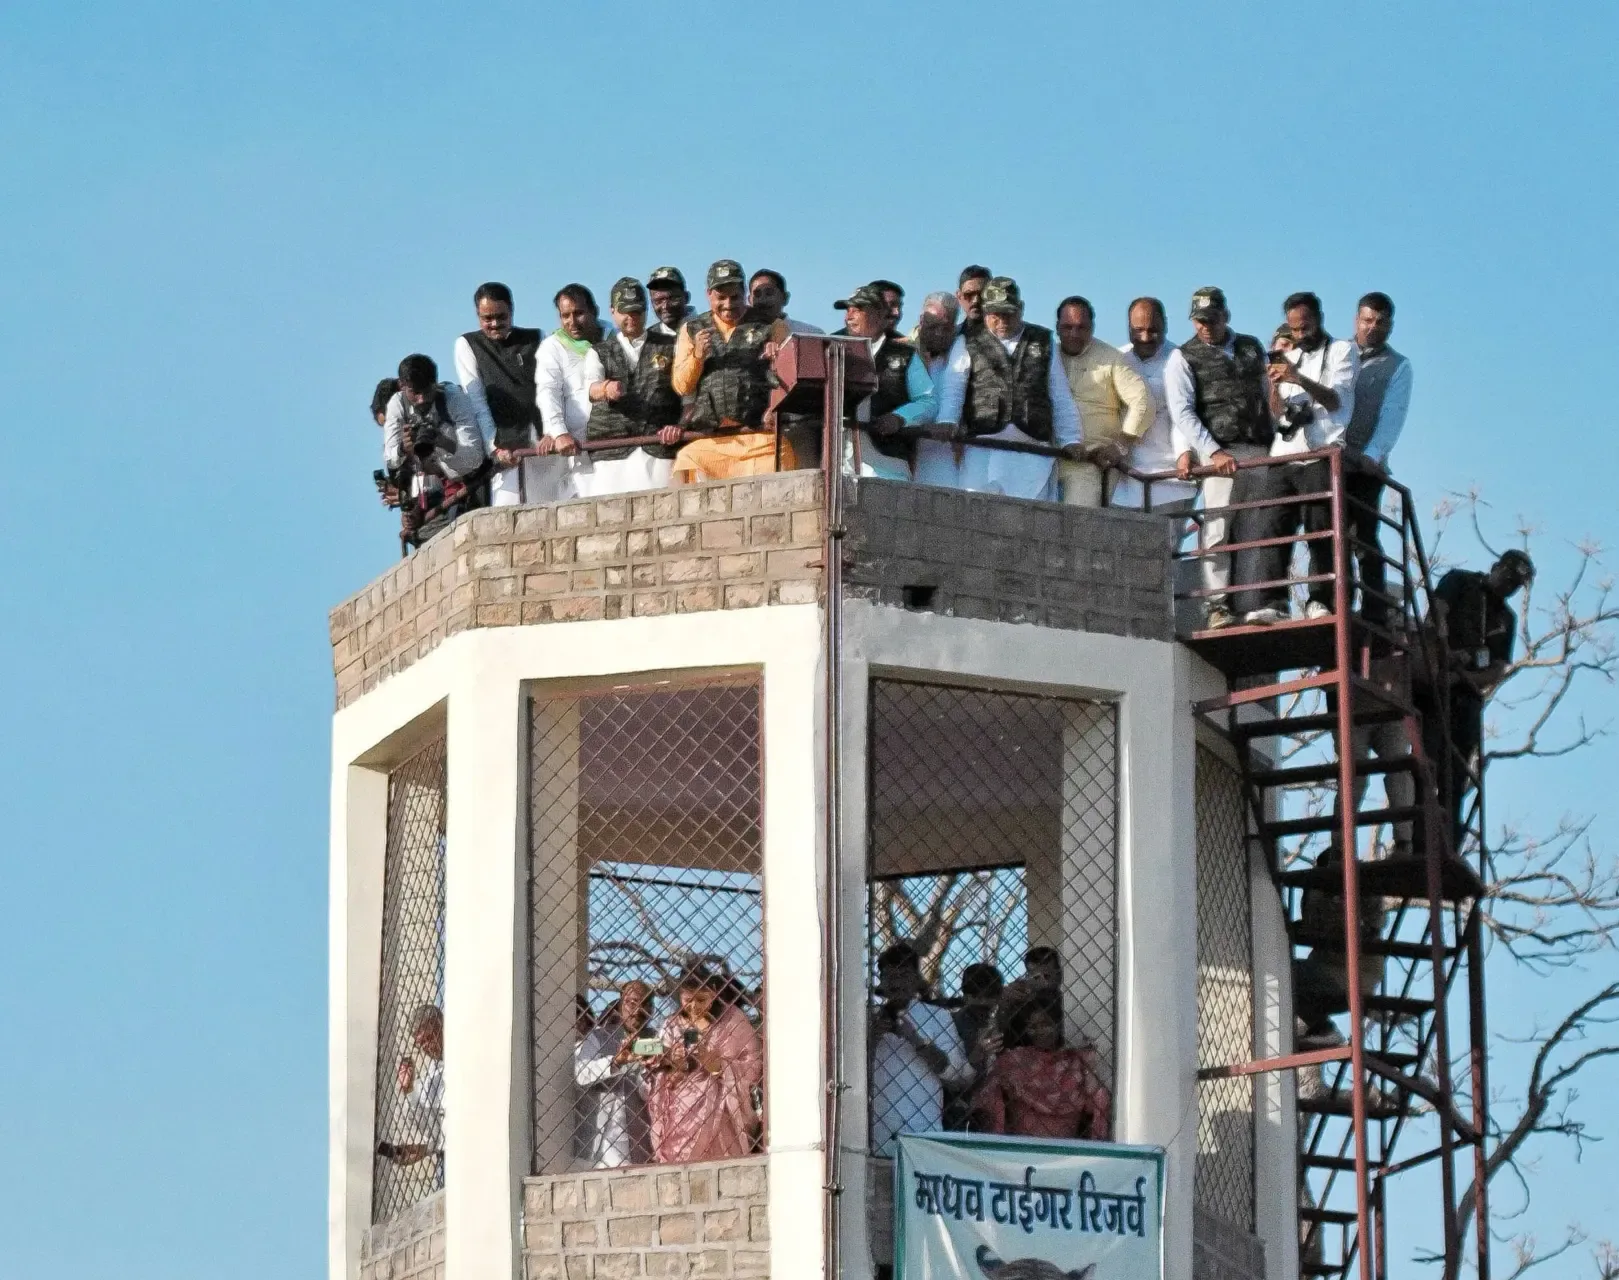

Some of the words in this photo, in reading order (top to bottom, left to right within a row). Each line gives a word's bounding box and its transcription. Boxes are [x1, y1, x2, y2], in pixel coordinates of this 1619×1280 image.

[914, 1171, 985, 1222] माधव
[990, 1166, 1073, 1234] टाईगर
[1078, 1170, 1147, 1237] रिजर्व
